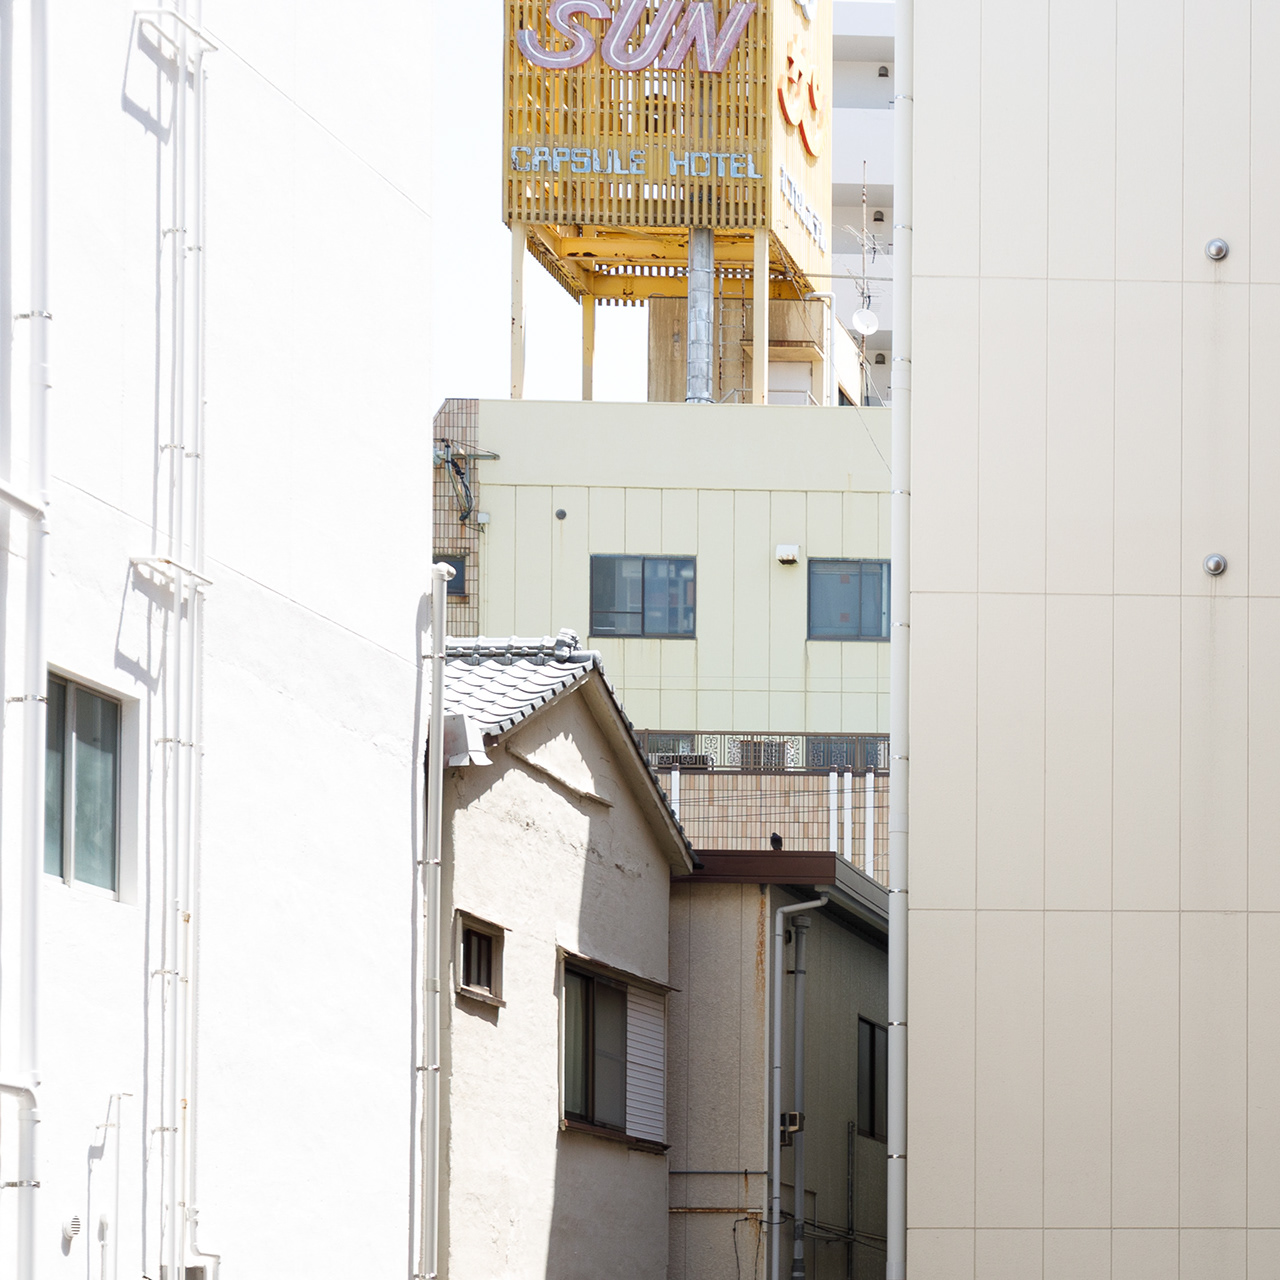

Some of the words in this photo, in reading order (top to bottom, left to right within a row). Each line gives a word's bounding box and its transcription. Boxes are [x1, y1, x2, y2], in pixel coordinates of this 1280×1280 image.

[517, 0, 757, 73] SUN
[510, 146, 646, 175] CAPSULE
[669, 151, 763, 179] HOTEL
